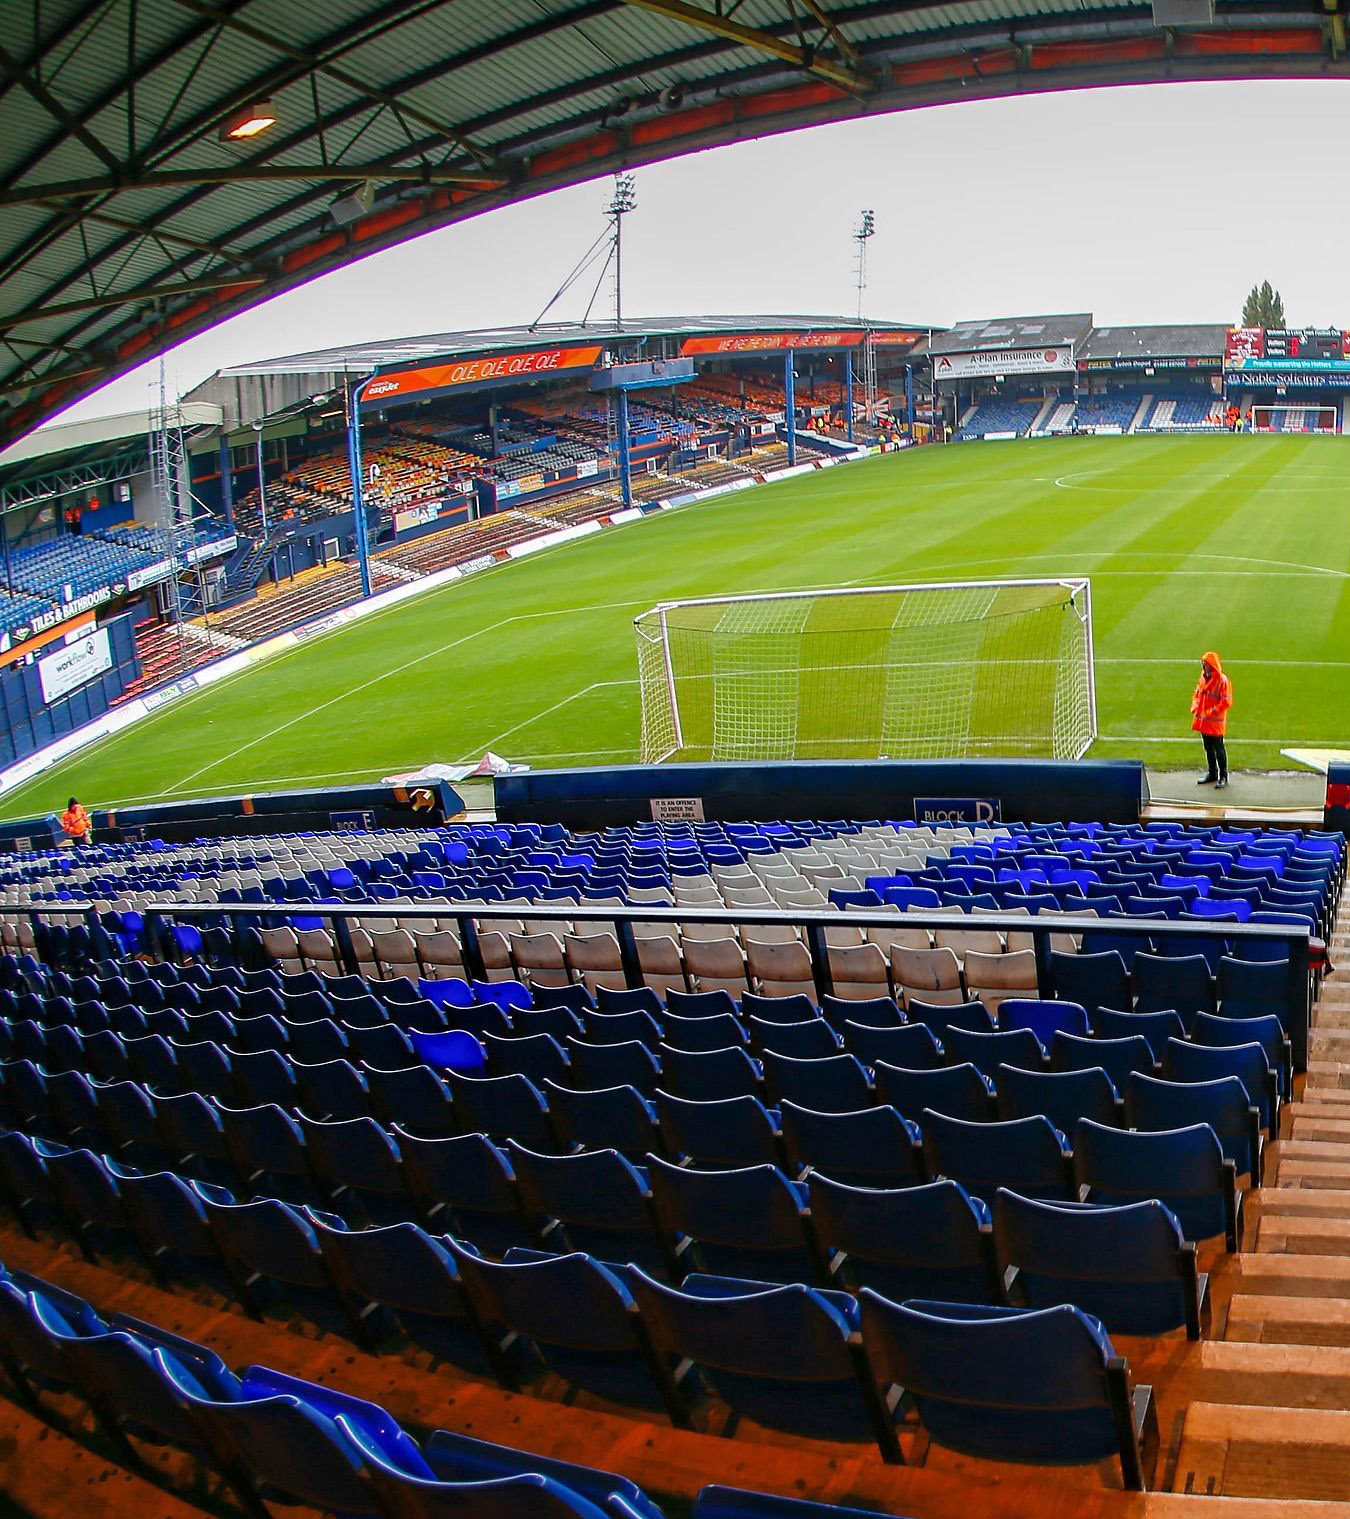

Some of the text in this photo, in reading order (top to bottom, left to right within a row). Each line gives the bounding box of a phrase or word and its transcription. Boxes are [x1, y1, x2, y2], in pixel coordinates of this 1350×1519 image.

[1000, 351, 1042, 362] Insurance
[1273, 361, 1301, 369] supporting
[1241, 373, 1275, 383] Noble
[1275, 373, 1326, 384] Solicitors
[368, 382, 400, 395] easyJet
[31, 585, 111, 633] TILES & BATHROOMS
[56, 652, 87, 673] workflow
[925, 801, 994, 822] BLOCK D
[336, 813, 373, 831] BLOCK E
